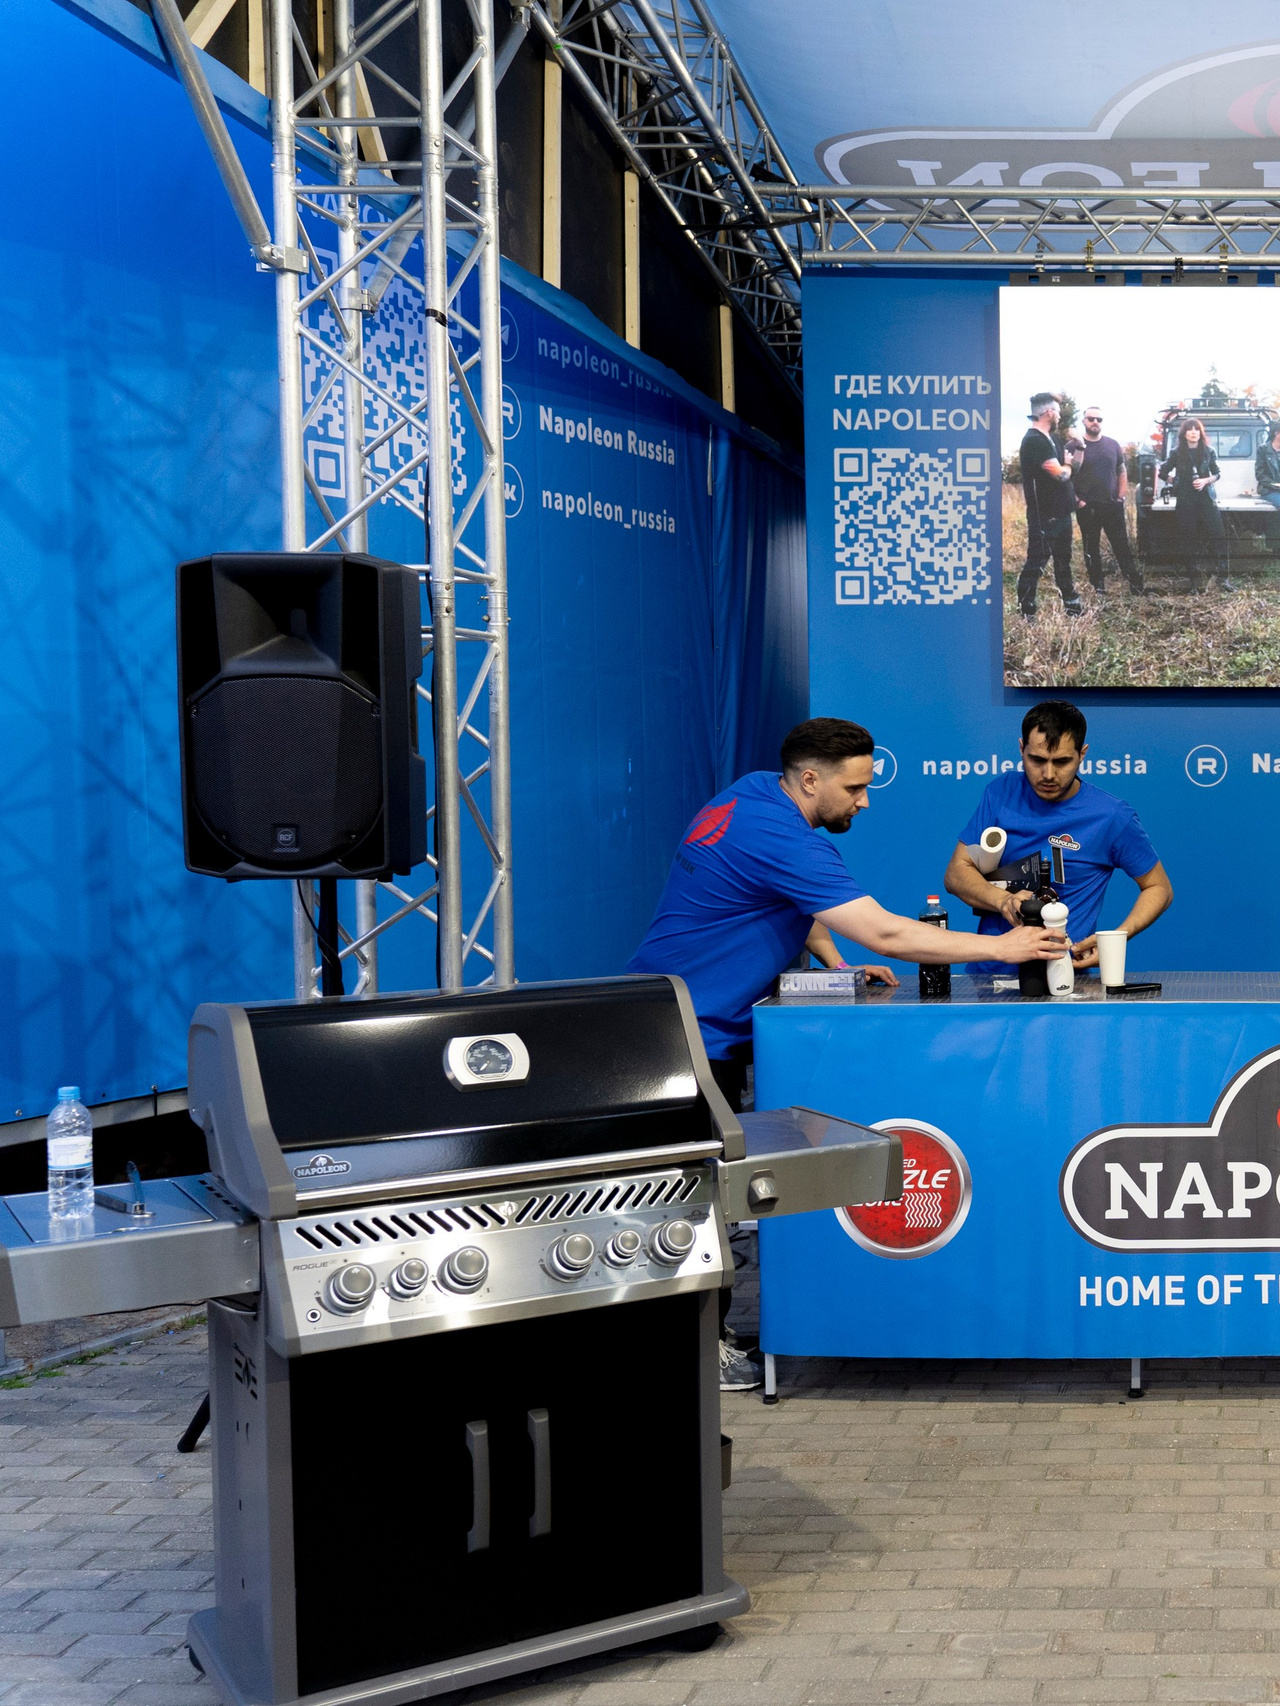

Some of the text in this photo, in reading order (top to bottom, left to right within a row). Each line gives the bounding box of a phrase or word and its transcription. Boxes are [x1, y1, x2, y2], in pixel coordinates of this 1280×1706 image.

[834, 374, 992, 398] ГДЕ КУПИТЬ
[833, 408, 991, 431] NAPOLEON
[539, 405, 675, 466] Napoleon Russia
[542, 489, 675, 533] napoleon_russia
[297, 1164, 347, 1177] NAPOLEON
[293, 1261, 329, 1271] ROGUE
[1079, 1276, 1186, 1306] HOME
[1197, 1275, 1245, 1305] OF
